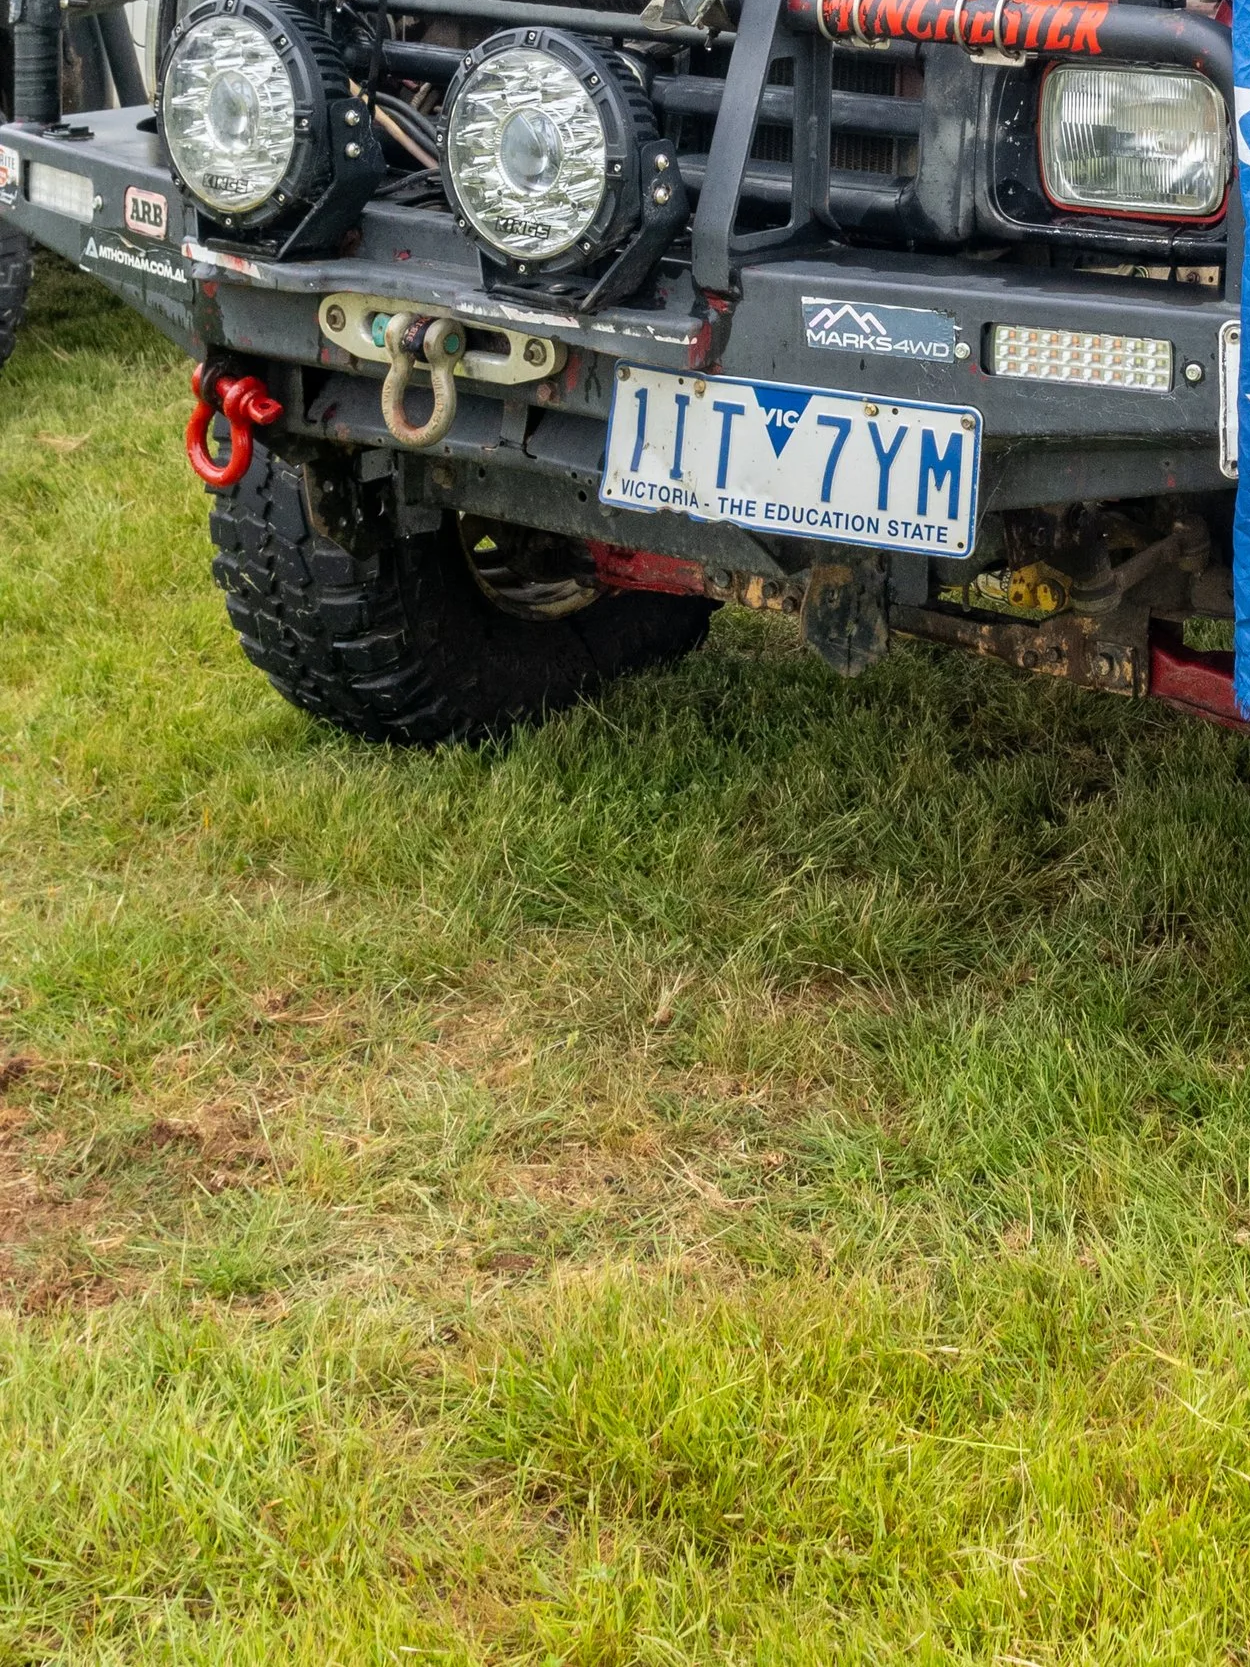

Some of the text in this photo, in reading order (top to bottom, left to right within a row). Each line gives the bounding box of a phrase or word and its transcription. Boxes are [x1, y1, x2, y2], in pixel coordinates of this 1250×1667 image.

[202, 173, 249, 194] KINGS
[130, 197, 163, 227] ARB
[495, 216, 551, 239] KINGS
[761, 407, 801, 429] VIC
[816, 414, 964, 521] 7YM
[621, 478, 700, 509] VICTORIA
[718, 496, 757, 517] THE
[764, 503, 880, 534] EDUCATION
[887, 519, 949, 543] STATE
